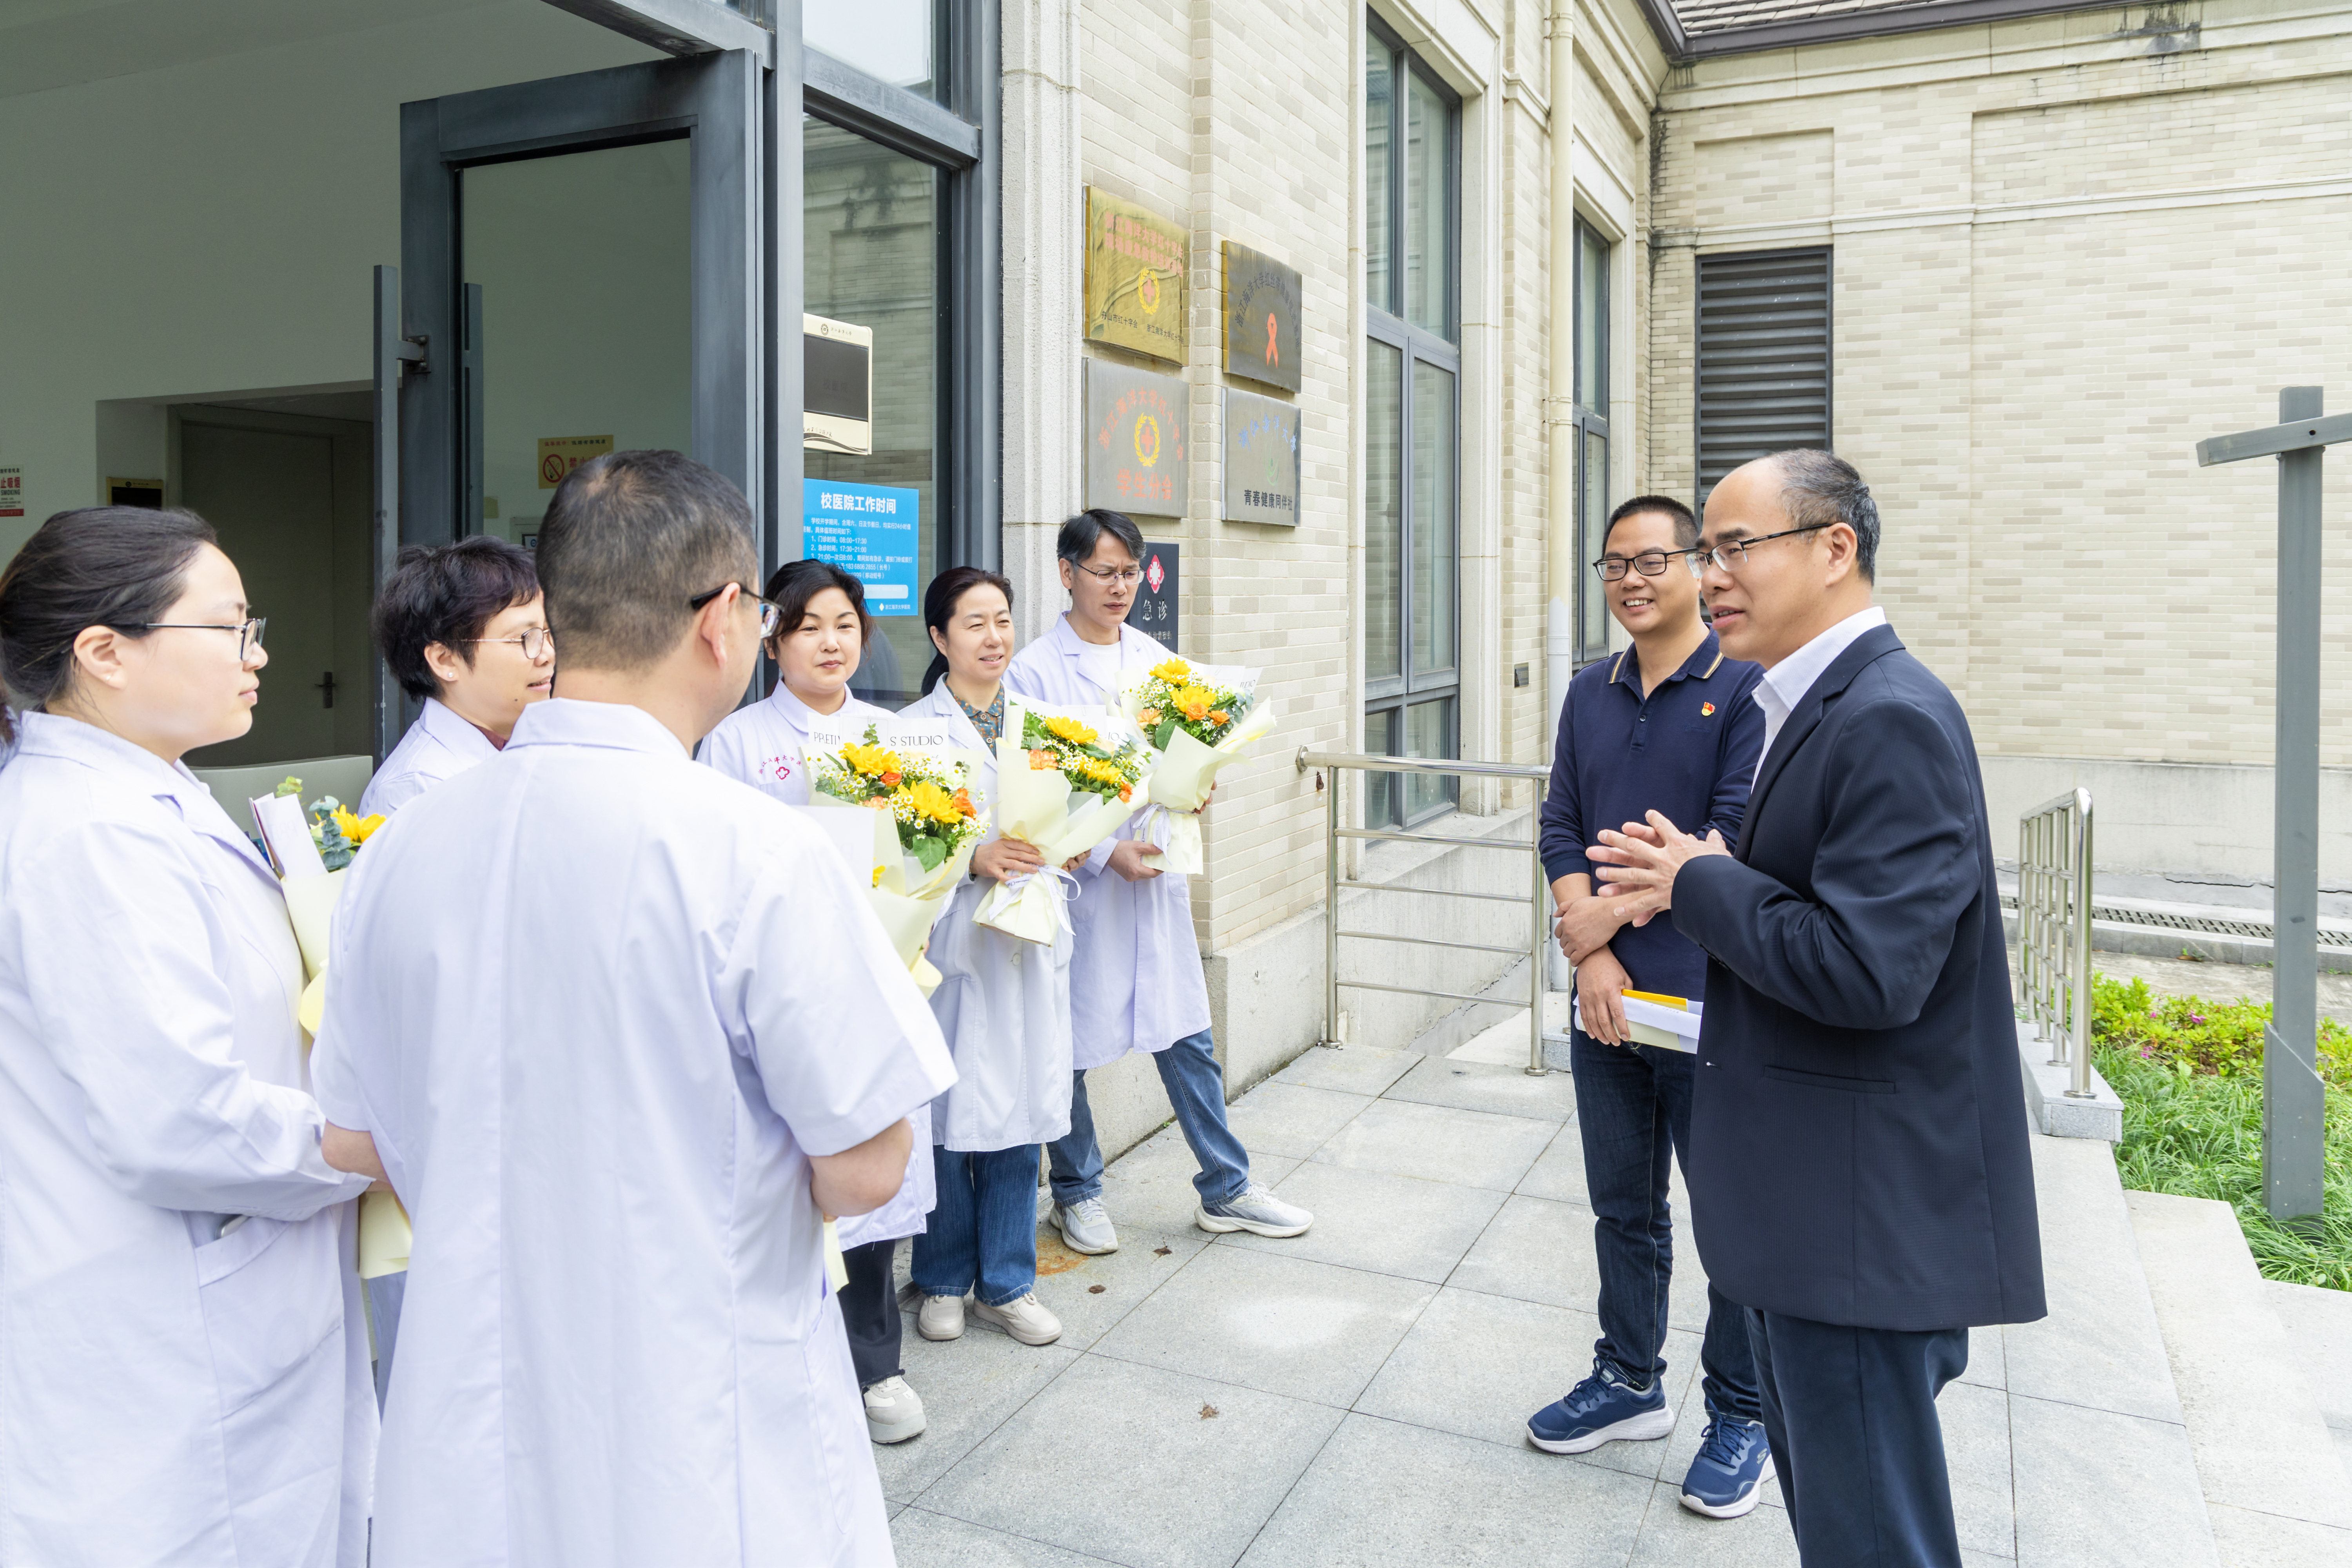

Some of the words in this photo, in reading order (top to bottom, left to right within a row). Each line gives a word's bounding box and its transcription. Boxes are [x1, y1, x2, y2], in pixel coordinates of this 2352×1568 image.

[1105, 212, 1183, 259] 浙江海洋大学红十字会
[1105, 232, 1183, 278] 现场应急救护培训基地
[1102, 310, 1138, 328] 舟山市红十字会
[1147, 324, 1184, 344] 浙江海洋大学红十字会
[1098, 387, 1183, 461] 浙江海洋大学红十字会
[1117, 469, 1172, 500] 学生分会
[1244, 489, 1292, 511] 青春健康同伴社
[821, 492, 896, 514] 校医院工作时间
[1143, 599, 1168, 621] 急诊
[900, 735, 943, 746] STUDIO
